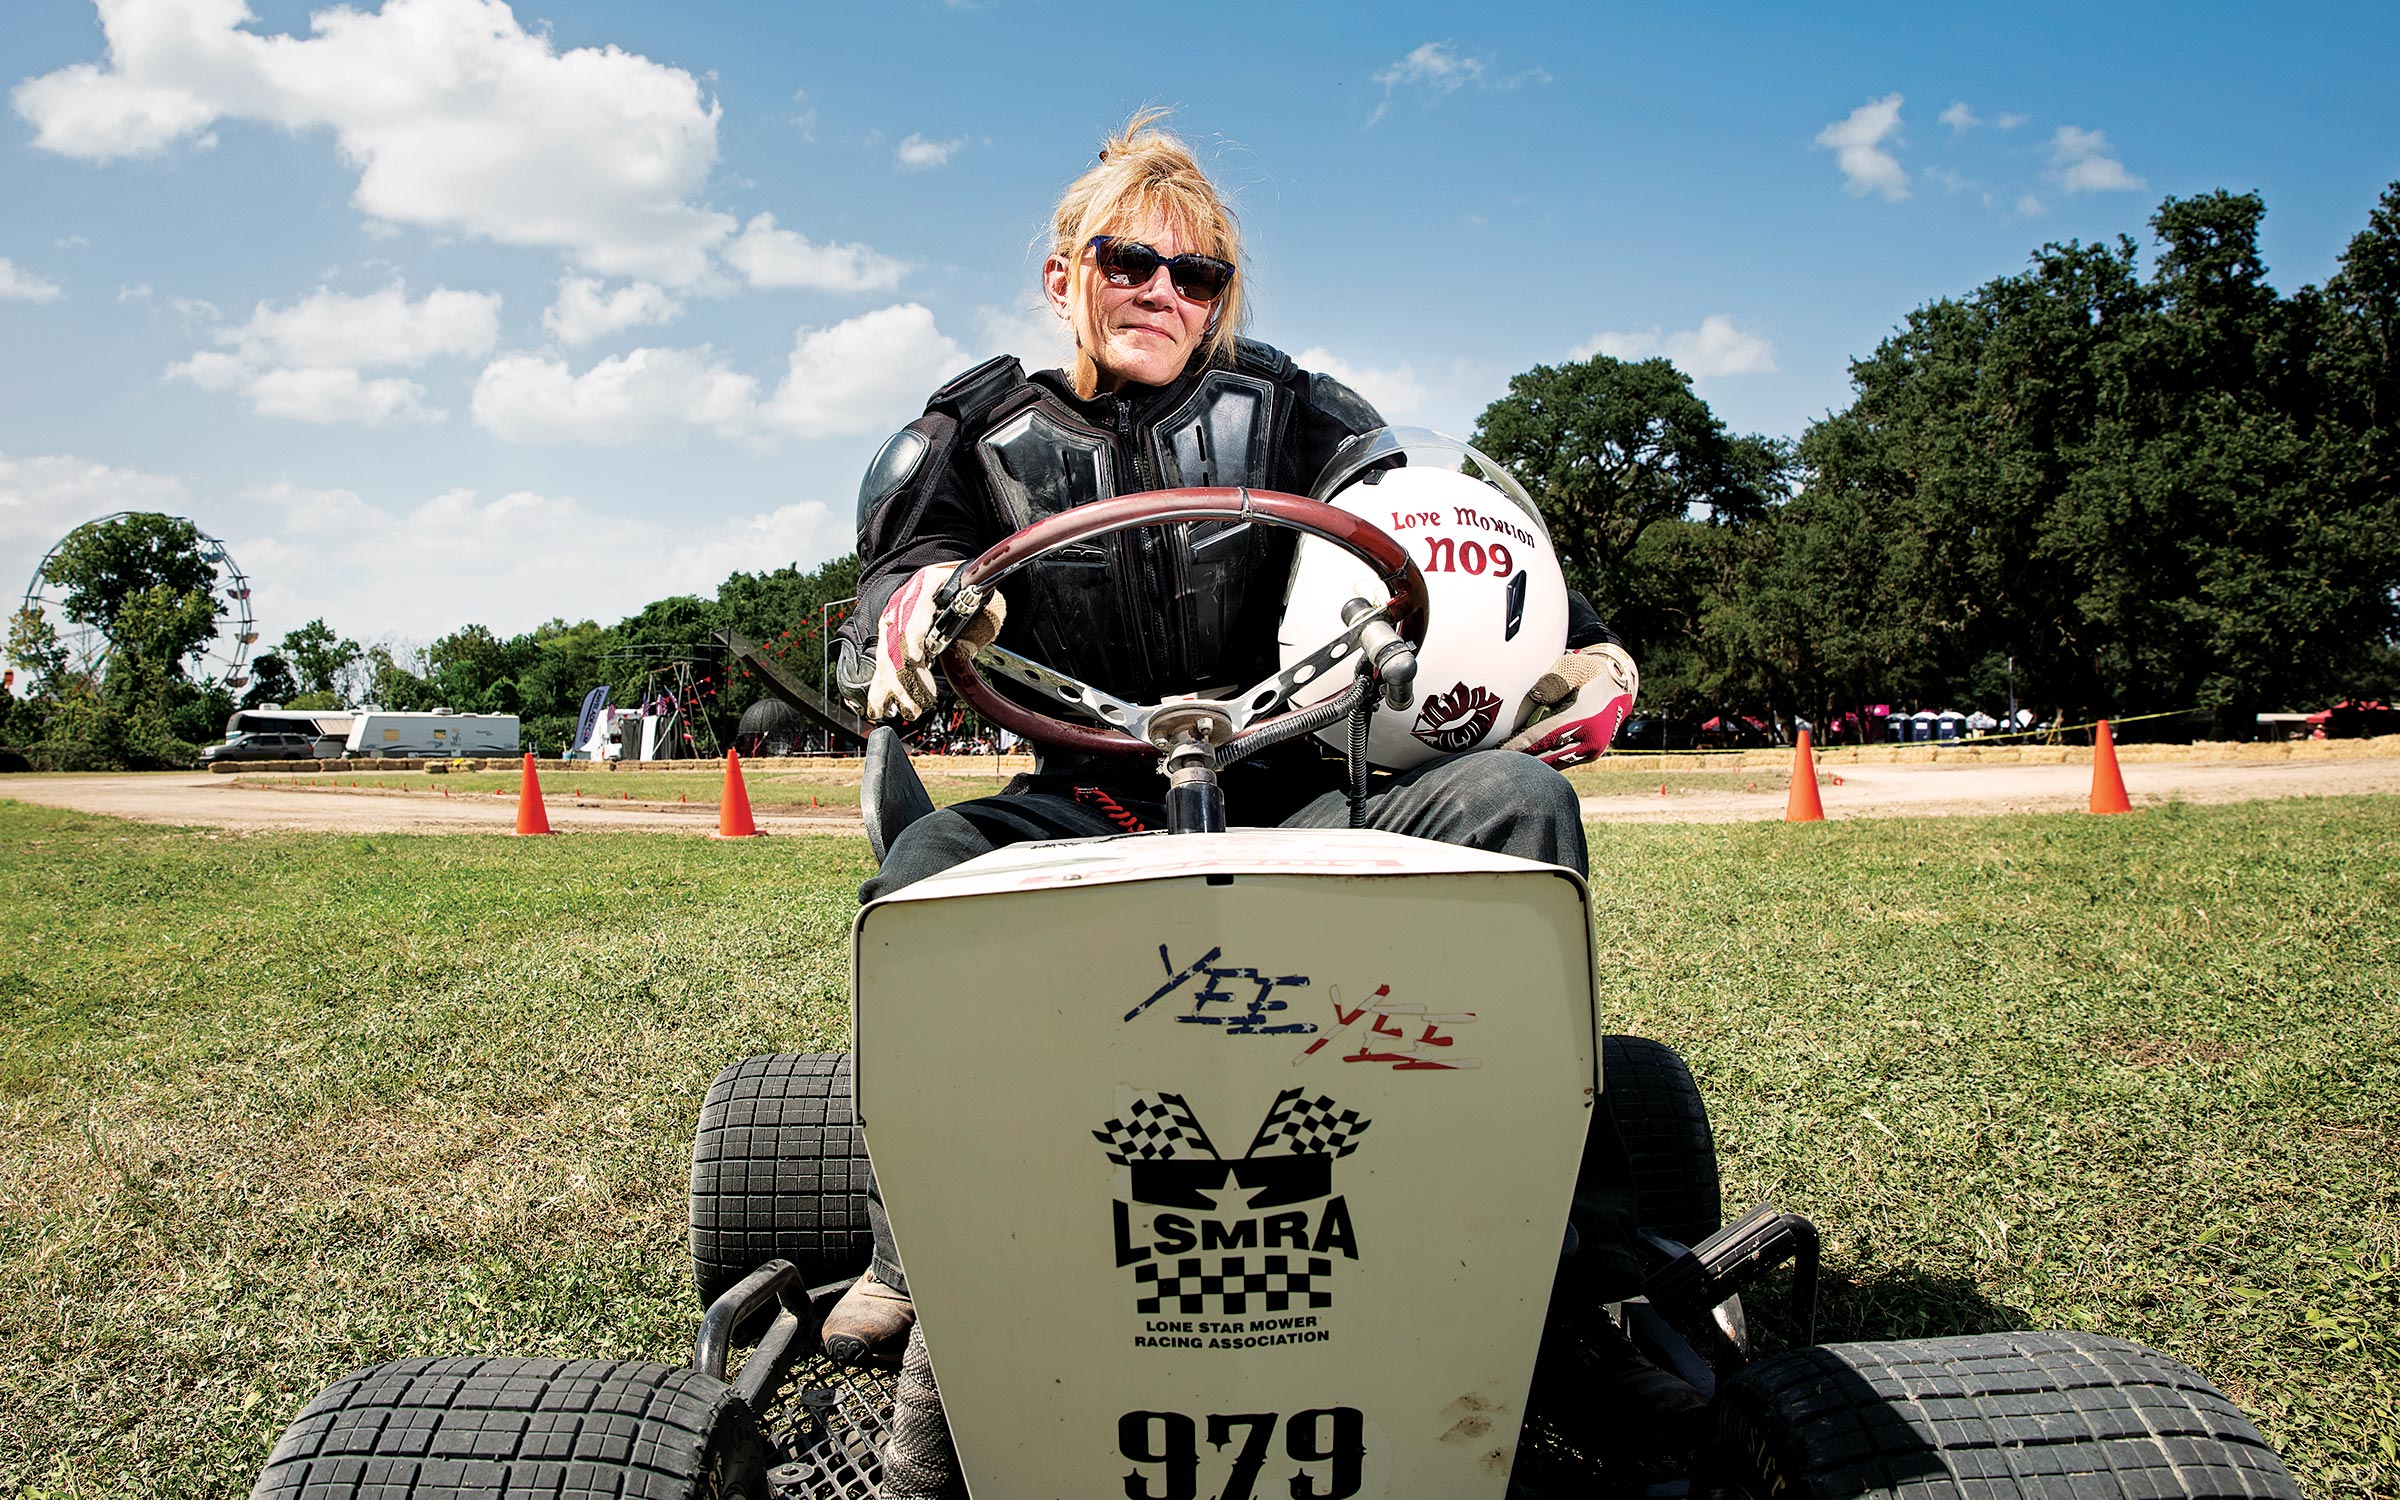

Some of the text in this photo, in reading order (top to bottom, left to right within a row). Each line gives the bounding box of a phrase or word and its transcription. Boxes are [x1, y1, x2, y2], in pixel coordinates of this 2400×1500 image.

[1391, 511, 1441, 531] Love
[1124, 943, 1483, 1071] YEE YEE
[1112, 1195, 1360, 1268] LSMRA
[1134, 1330, 1330, 1350] RACING ASSOCIATION
[1146, 1315, 1318, 1334] LONE STAR MOWER
[1118, 1406, 1368, 1500] 979
